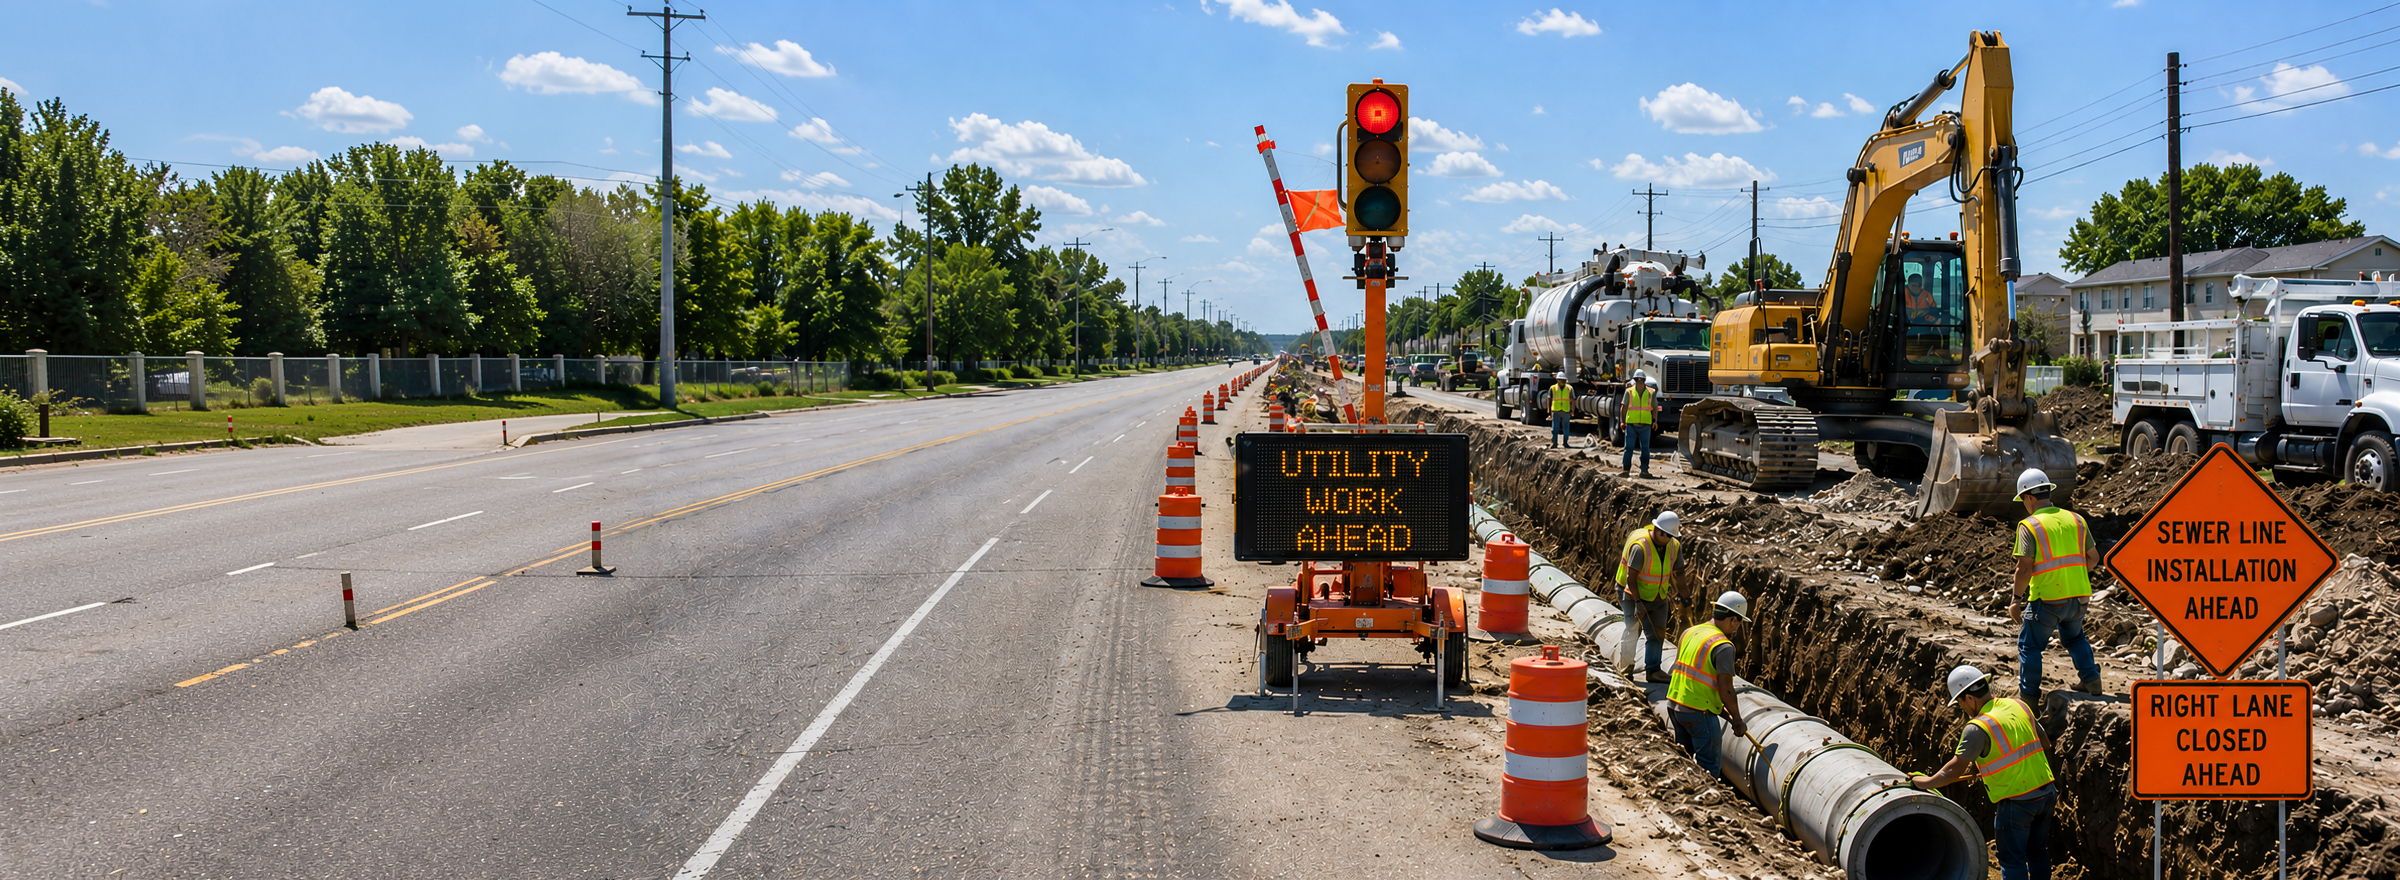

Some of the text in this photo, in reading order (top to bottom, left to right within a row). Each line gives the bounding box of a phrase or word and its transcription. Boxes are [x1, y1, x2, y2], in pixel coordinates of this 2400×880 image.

[1281, 450, 1428, 477] UTILITY
[1306, 488, 1403, 514] WORK
[1297, 525, 1411, 551] AHEAD
[2157, 521, 2286, 544] SEWER LINE
[2147, 558, 2297, 582] INSTALLATION
[2185, 597, 2258, 620] AHEAD
[2151, 694, 2293, 717] RIGHT LANE
[2176, 728, 2267, 752] CLOSED
[2182, 763, 2261, 786] AHEAD
